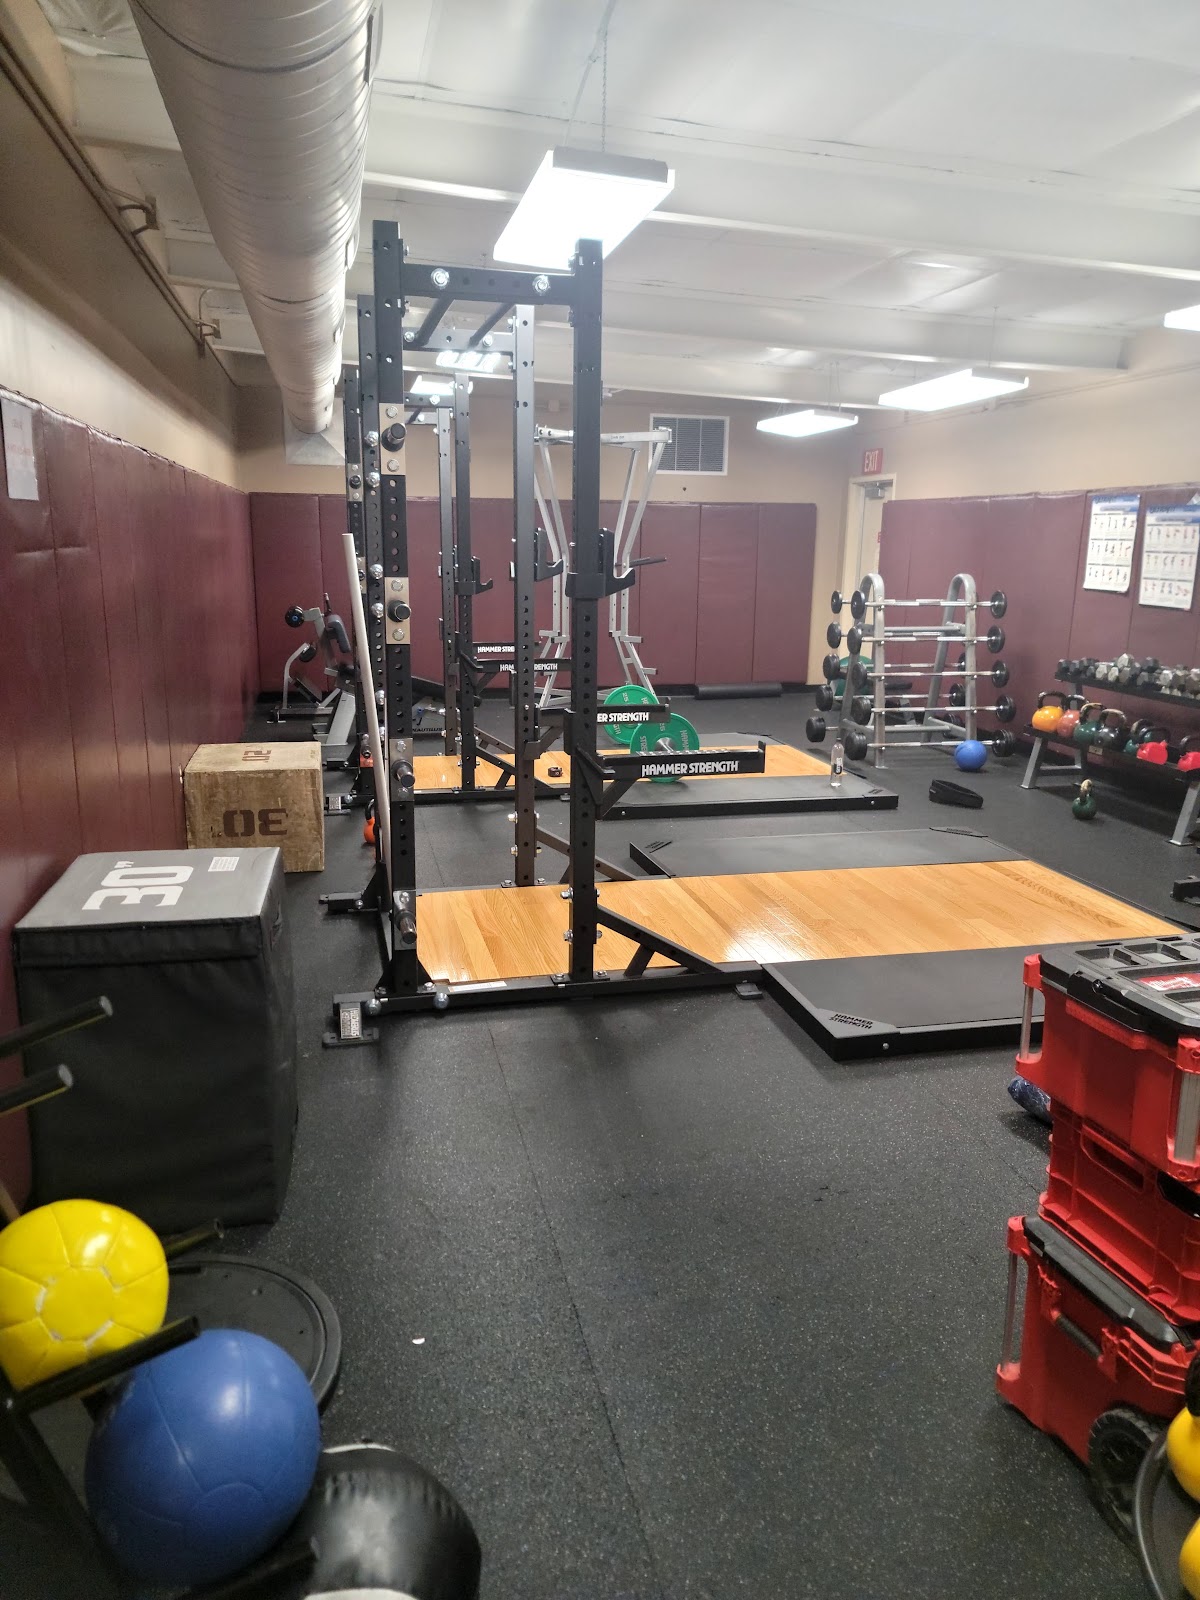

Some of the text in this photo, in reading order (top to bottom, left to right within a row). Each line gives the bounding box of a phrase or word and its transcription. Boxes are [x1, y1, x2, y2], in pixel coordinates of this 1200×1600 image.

[864, 450, 879, 472] EXIT
[501, 645, 515, 653] STRE
[500, 663, 558, 672] HAM RENGTH
[609, 712, 649, 722] STRENGTH
[642, 761, 739, 777] HAMMER STRENGTH
[829, 1017, 872, 1029] STRENGTH
[834, 1013, 873, 1025] HAMMER
